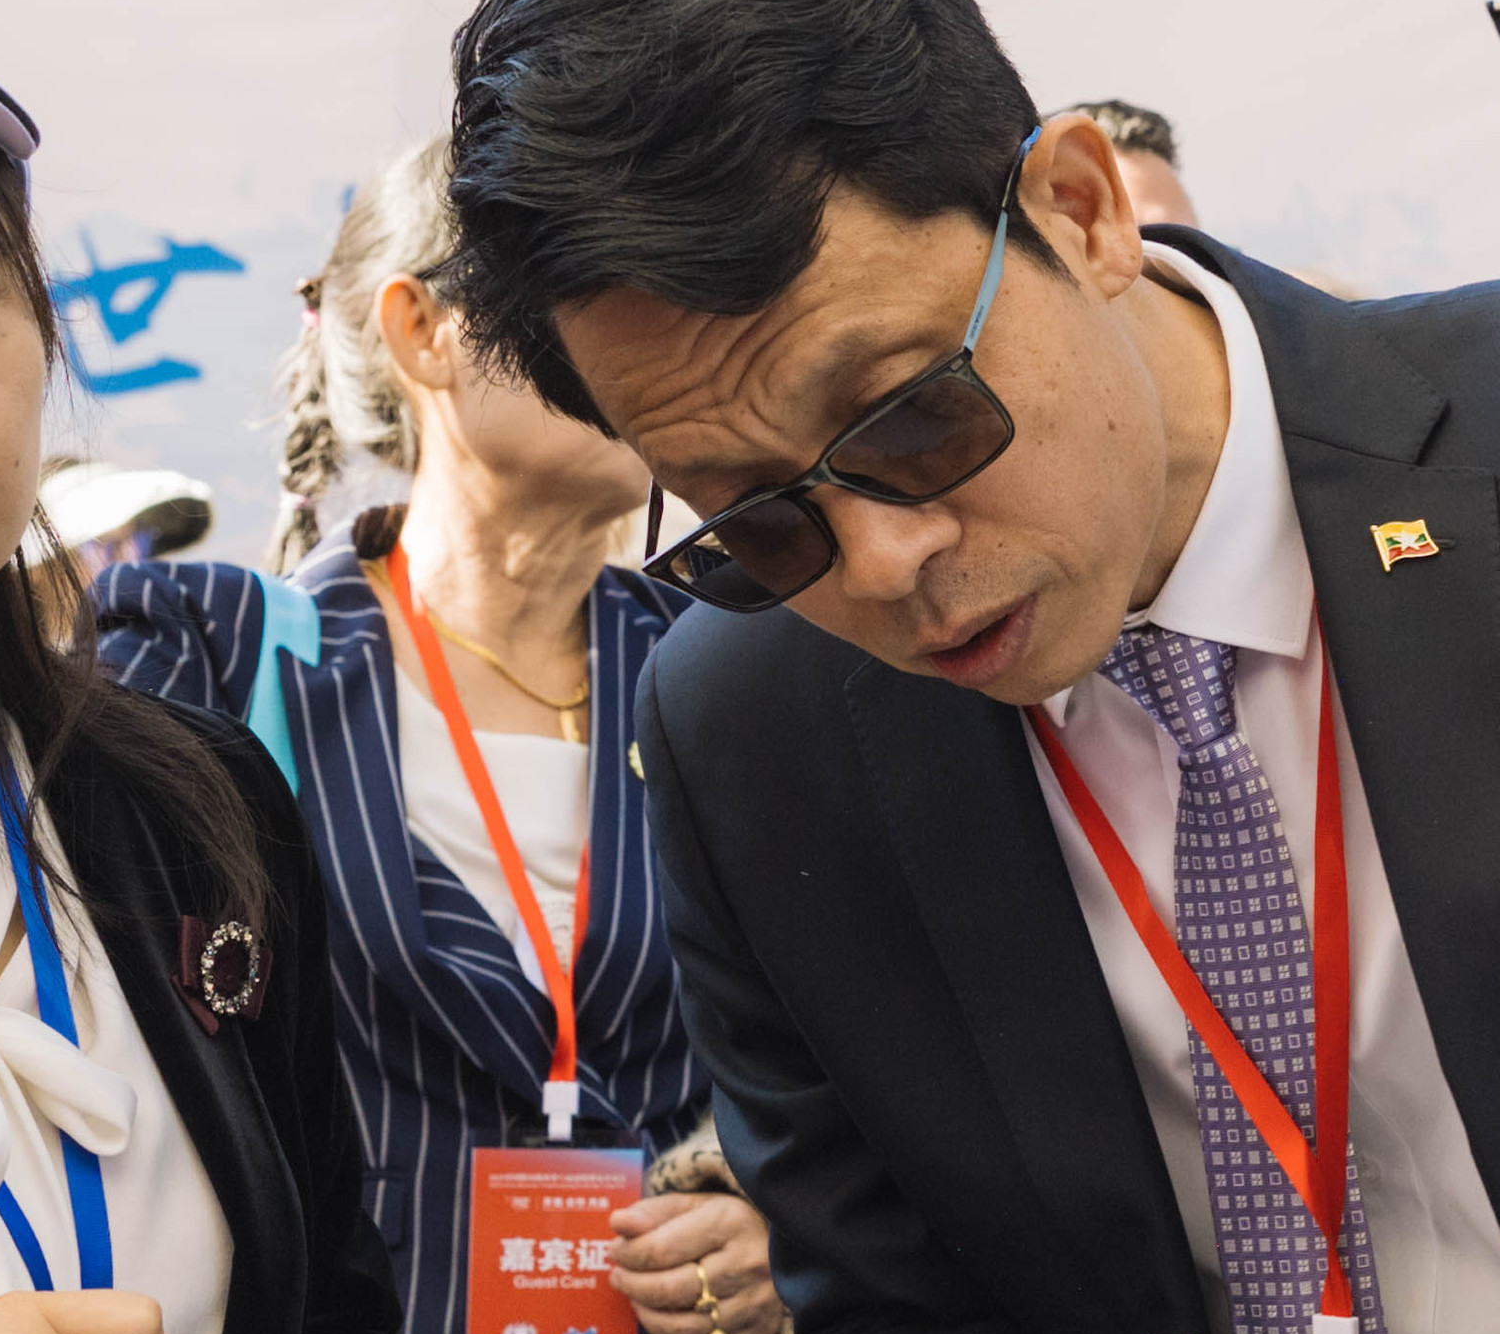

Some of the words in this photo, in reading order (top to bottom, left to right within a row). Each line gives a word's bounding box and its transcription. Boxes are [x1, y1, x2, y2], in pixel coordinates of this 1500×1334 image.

[48, 227, 246, 397] 世
[499, 1237, 614, 1273] 嘉宾证
[559, 1274, 597, 1289] Card
